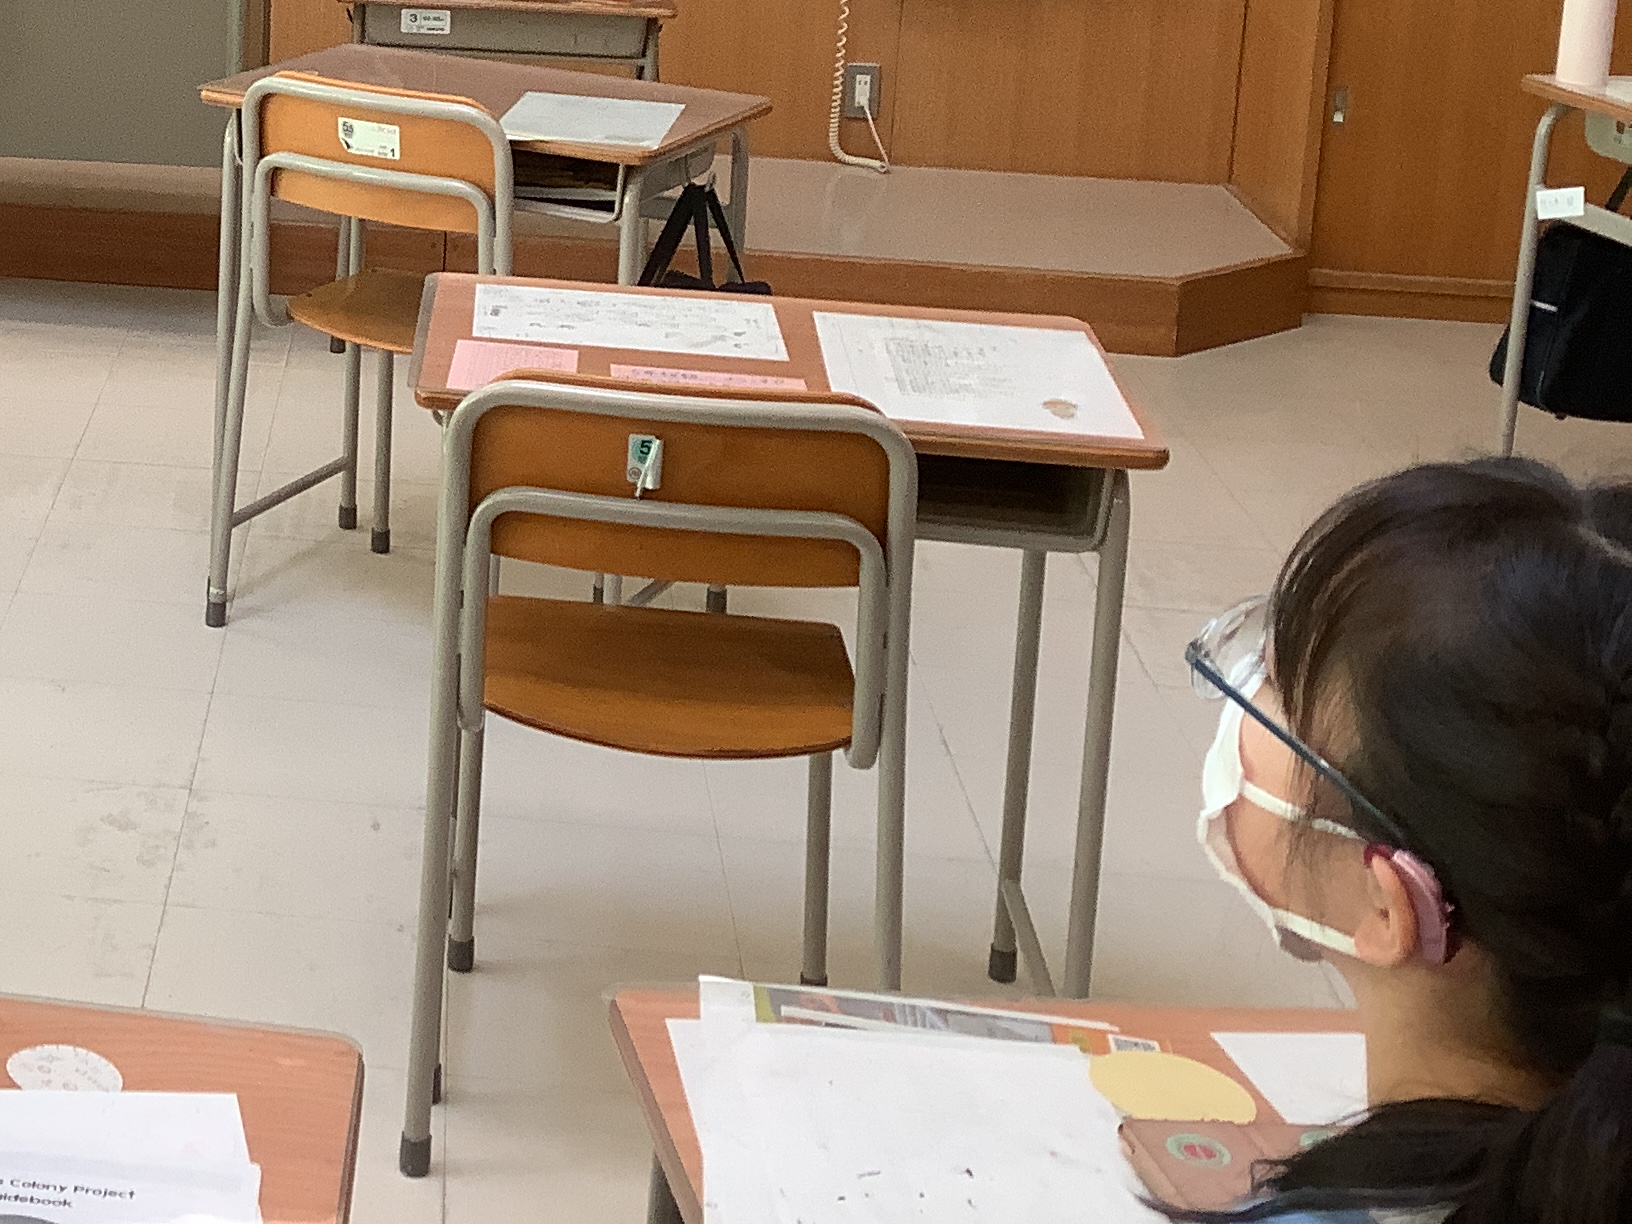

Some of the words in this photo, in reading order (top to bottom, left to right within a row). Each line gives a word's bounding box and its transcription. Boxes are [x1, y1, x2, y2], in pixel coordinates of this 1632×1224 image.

[409, 13, 419, 24] 3
[639, 440, 653, 456] 5
[9, 1179, 68, 1194] Colony
[73, 1185, 136, 1201] Project
